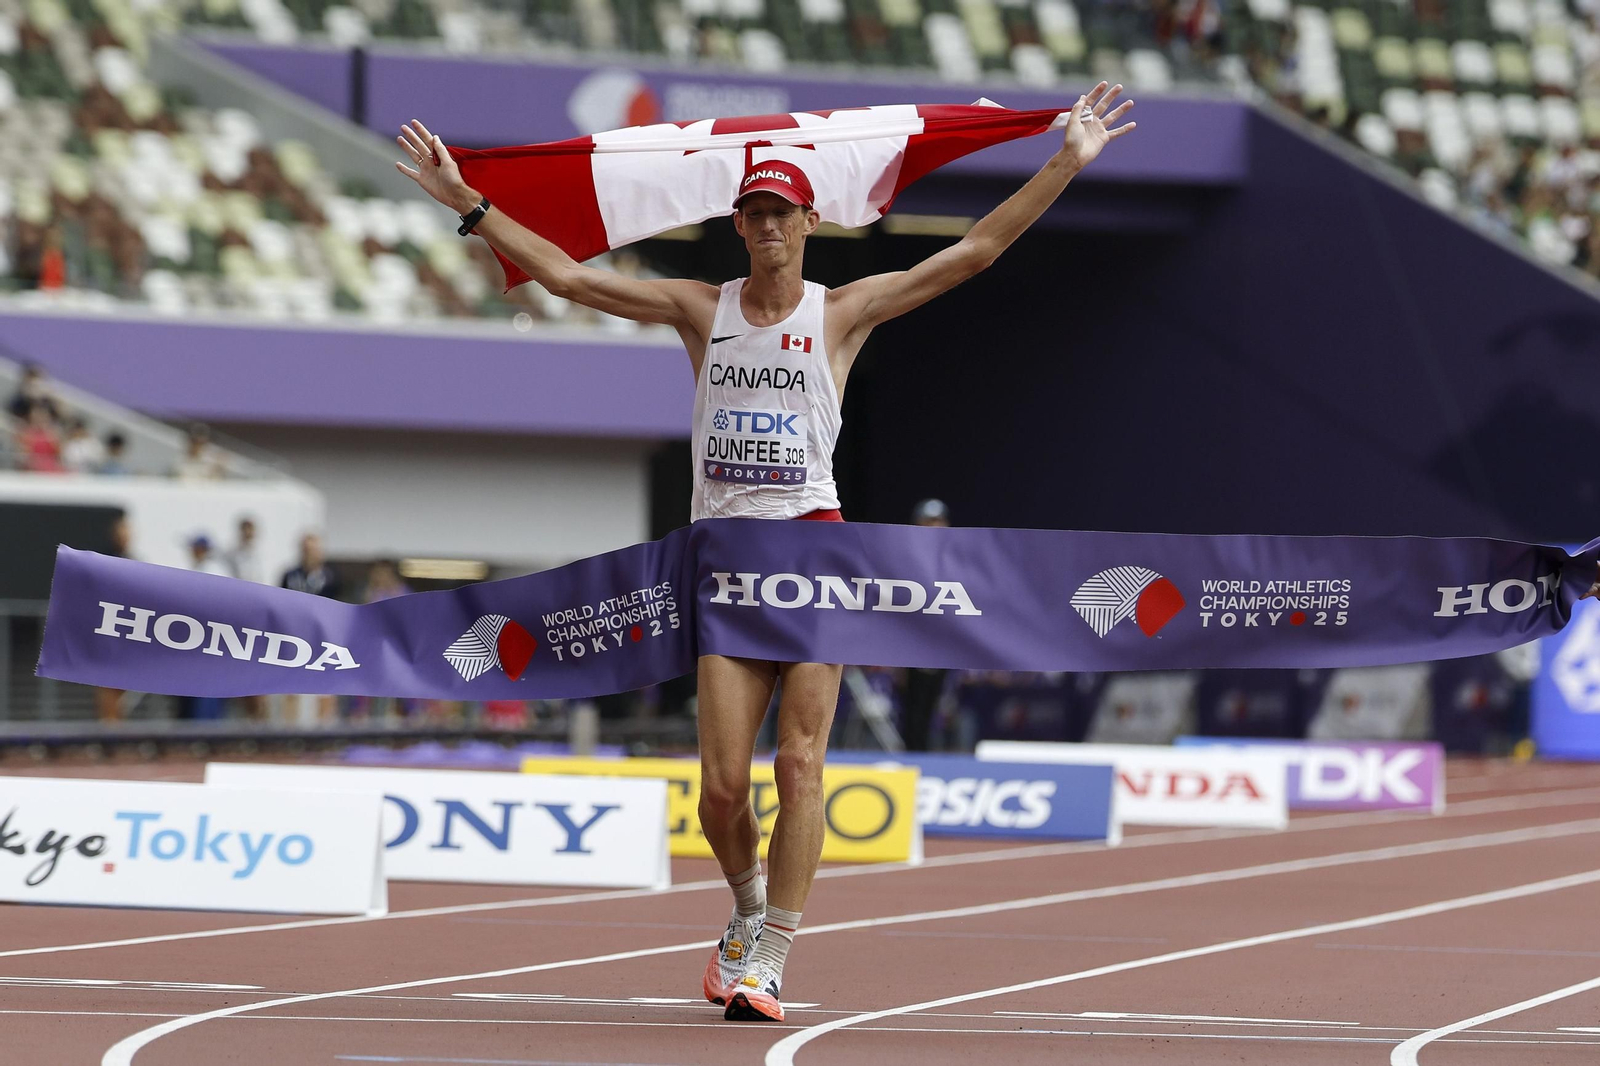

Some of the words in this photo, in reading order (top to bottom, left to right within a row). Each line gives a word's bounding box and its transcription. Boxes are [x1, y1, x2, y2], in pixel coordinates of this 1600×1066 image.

[744, 169, 792, 187] CANADA
[710, 363, 806, 393] CANADA
[729, 410, 799, 436] TDK
[707, 435, 781, 463] DUNFEE
[785, 447, 805, 465] 308
[709, 572, 982, 616] HONDA
[1202, 579, 1261, 593] WORLD
[1264, 579, 1351, 593] ATHLETICS
[541, 605, 594, 627] WORLD
[598, 581, 672, 615] ATHLETICS
[1200, 595, 1350, 610] CHAMPIONSHIPS
[546, 596, 677, 644] CHAMPIONSHIPS
[94, 600, 361, 671] HONDA
[1117, 771, 1266, 800] NDA
[1294, 748, 1426, 803] DK
[0, 805, 107, 887] kyo
[115, 811, 314, 879] Tokyo
